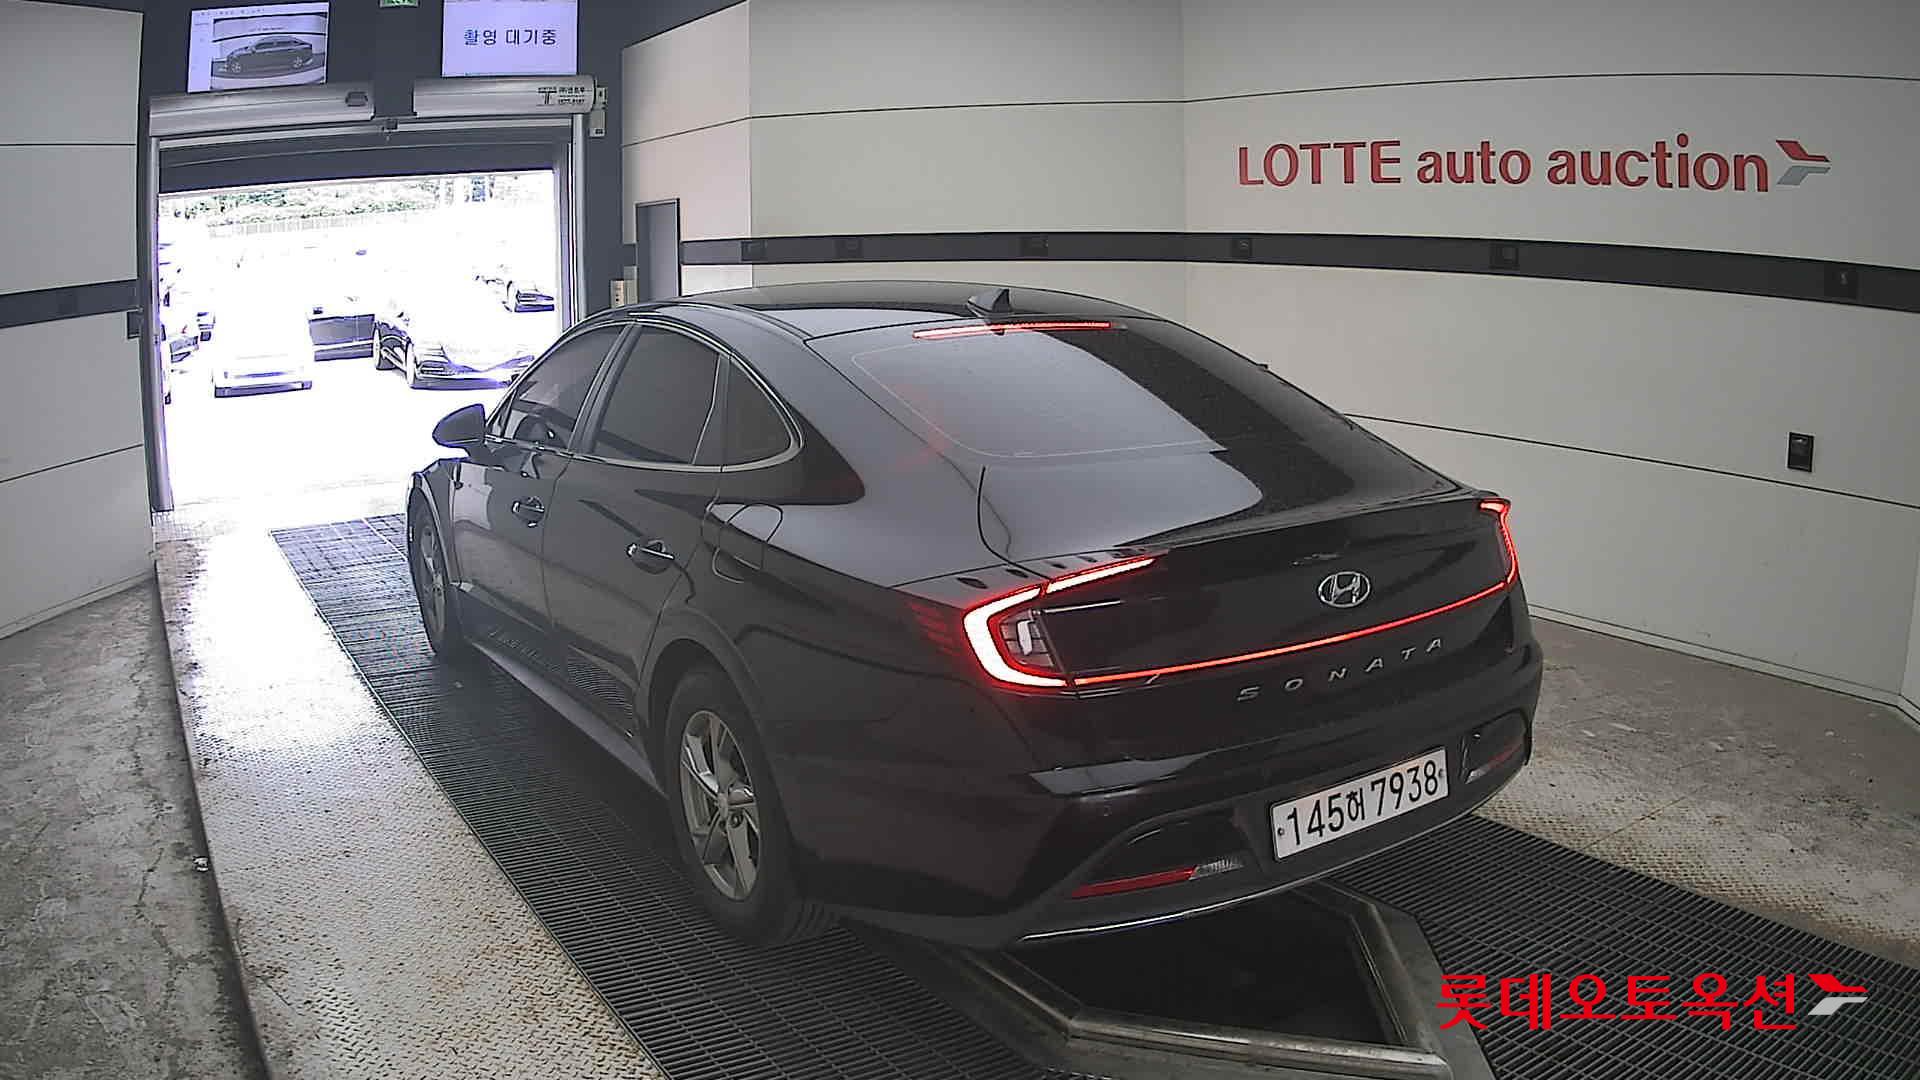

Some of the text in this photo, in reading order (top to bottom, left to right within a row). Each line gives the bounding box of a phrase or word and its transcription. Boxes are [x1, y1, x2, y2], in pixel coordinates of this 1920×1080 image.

[505, 28, 557, 46] 대기중
[1238, 134, 1769, 192] LOTTE auto auction
[1237, 637, 1442, 701] SONATA
